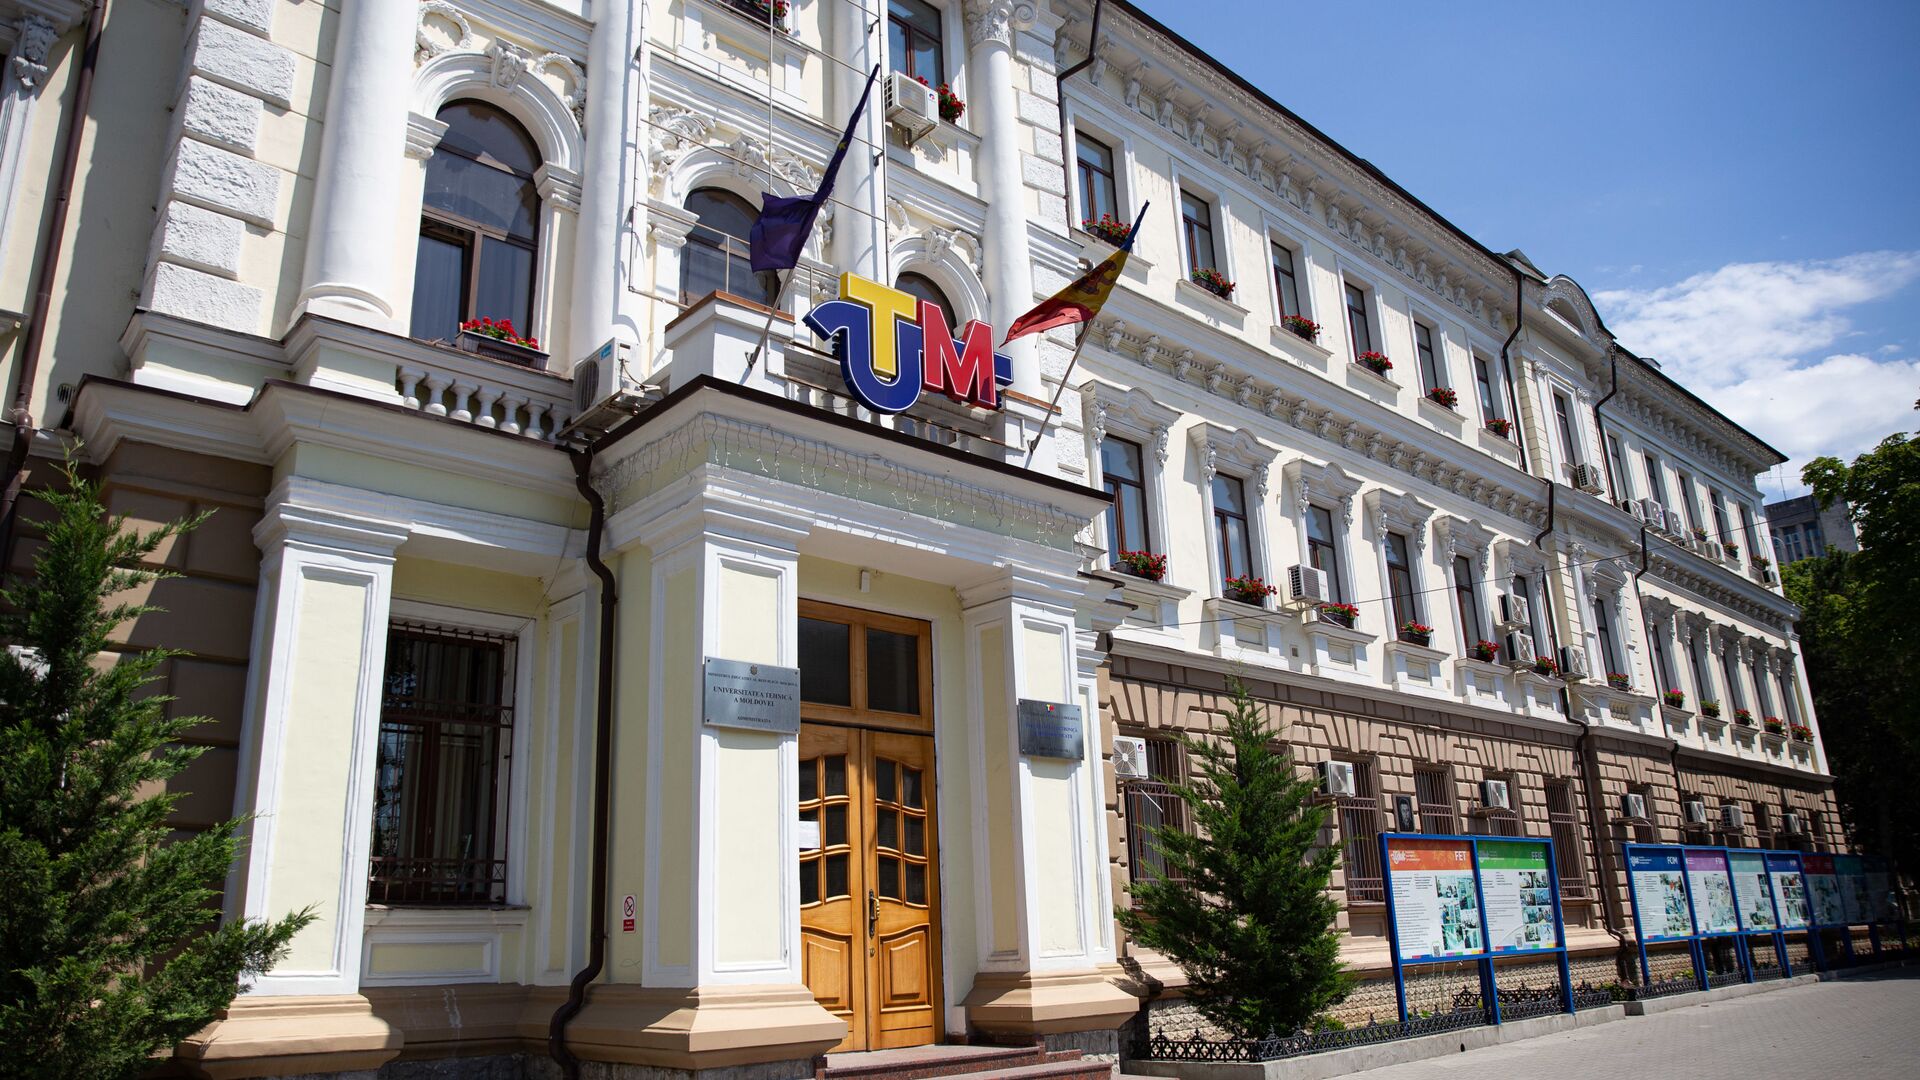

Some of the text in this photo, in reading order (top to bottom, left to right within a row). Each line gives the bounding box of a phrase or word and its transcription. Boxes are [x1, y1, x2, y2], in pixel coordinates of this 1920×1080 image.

[713, 686, 793, 701] UNIVERSITATEA TEHNICĂ
[740, 697, 775, 707] MOLDOVEI
[1454, 851, 1466, 861] FET
